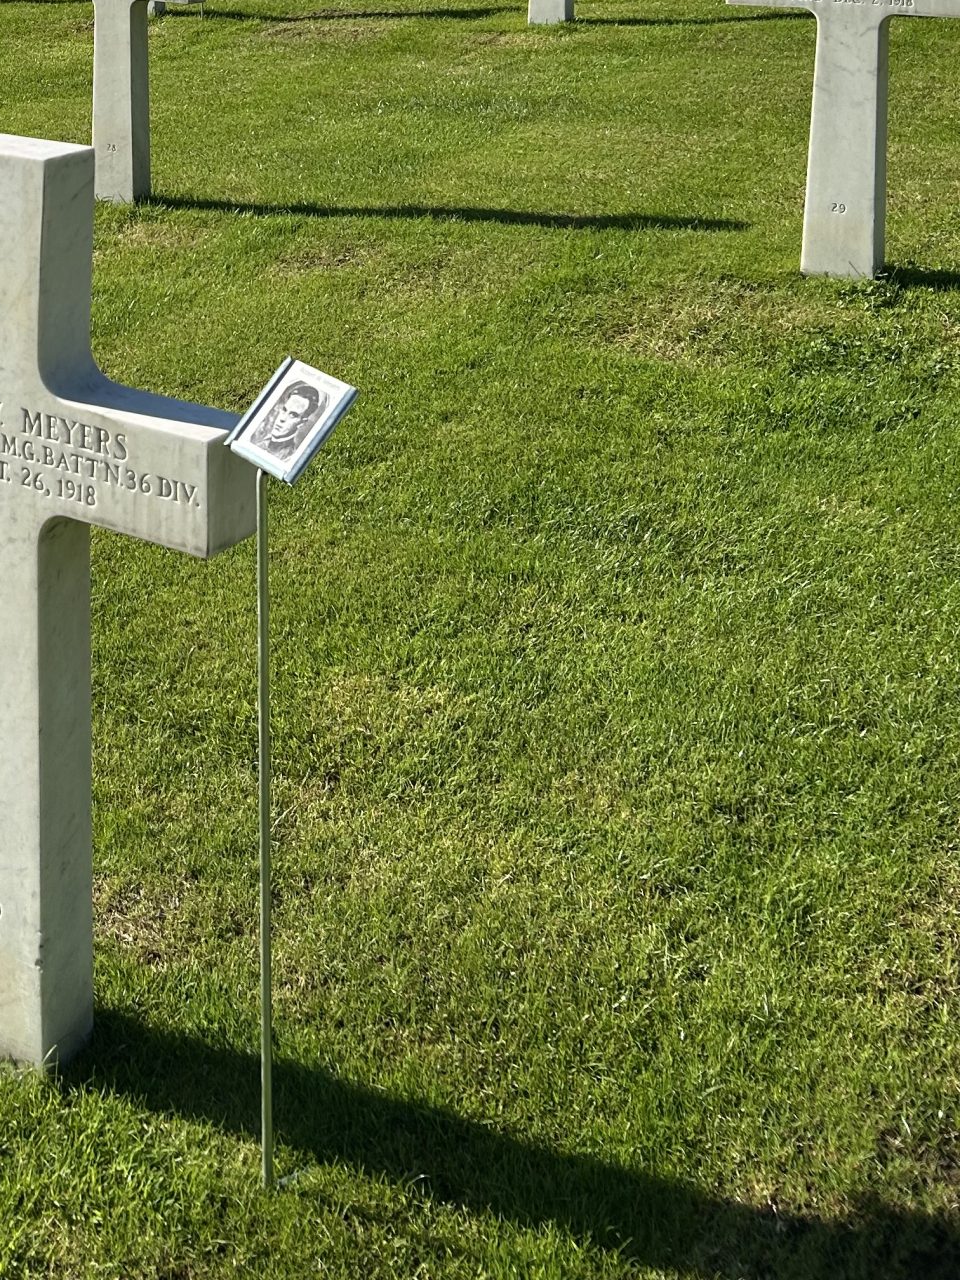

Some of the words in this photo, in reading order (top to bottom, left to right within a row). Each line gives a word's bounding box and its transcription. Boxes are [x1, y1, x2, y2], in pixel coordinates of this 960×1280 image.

[831, 203, 847, 214] 29
[21, 408, 128, 462] MEYERS
[20, 468, 51, 497] 26,
[56, 480, 97, 507] 1918
[126, 468, 151, 494] 36
[157, 476, 201, 508] DIV.
